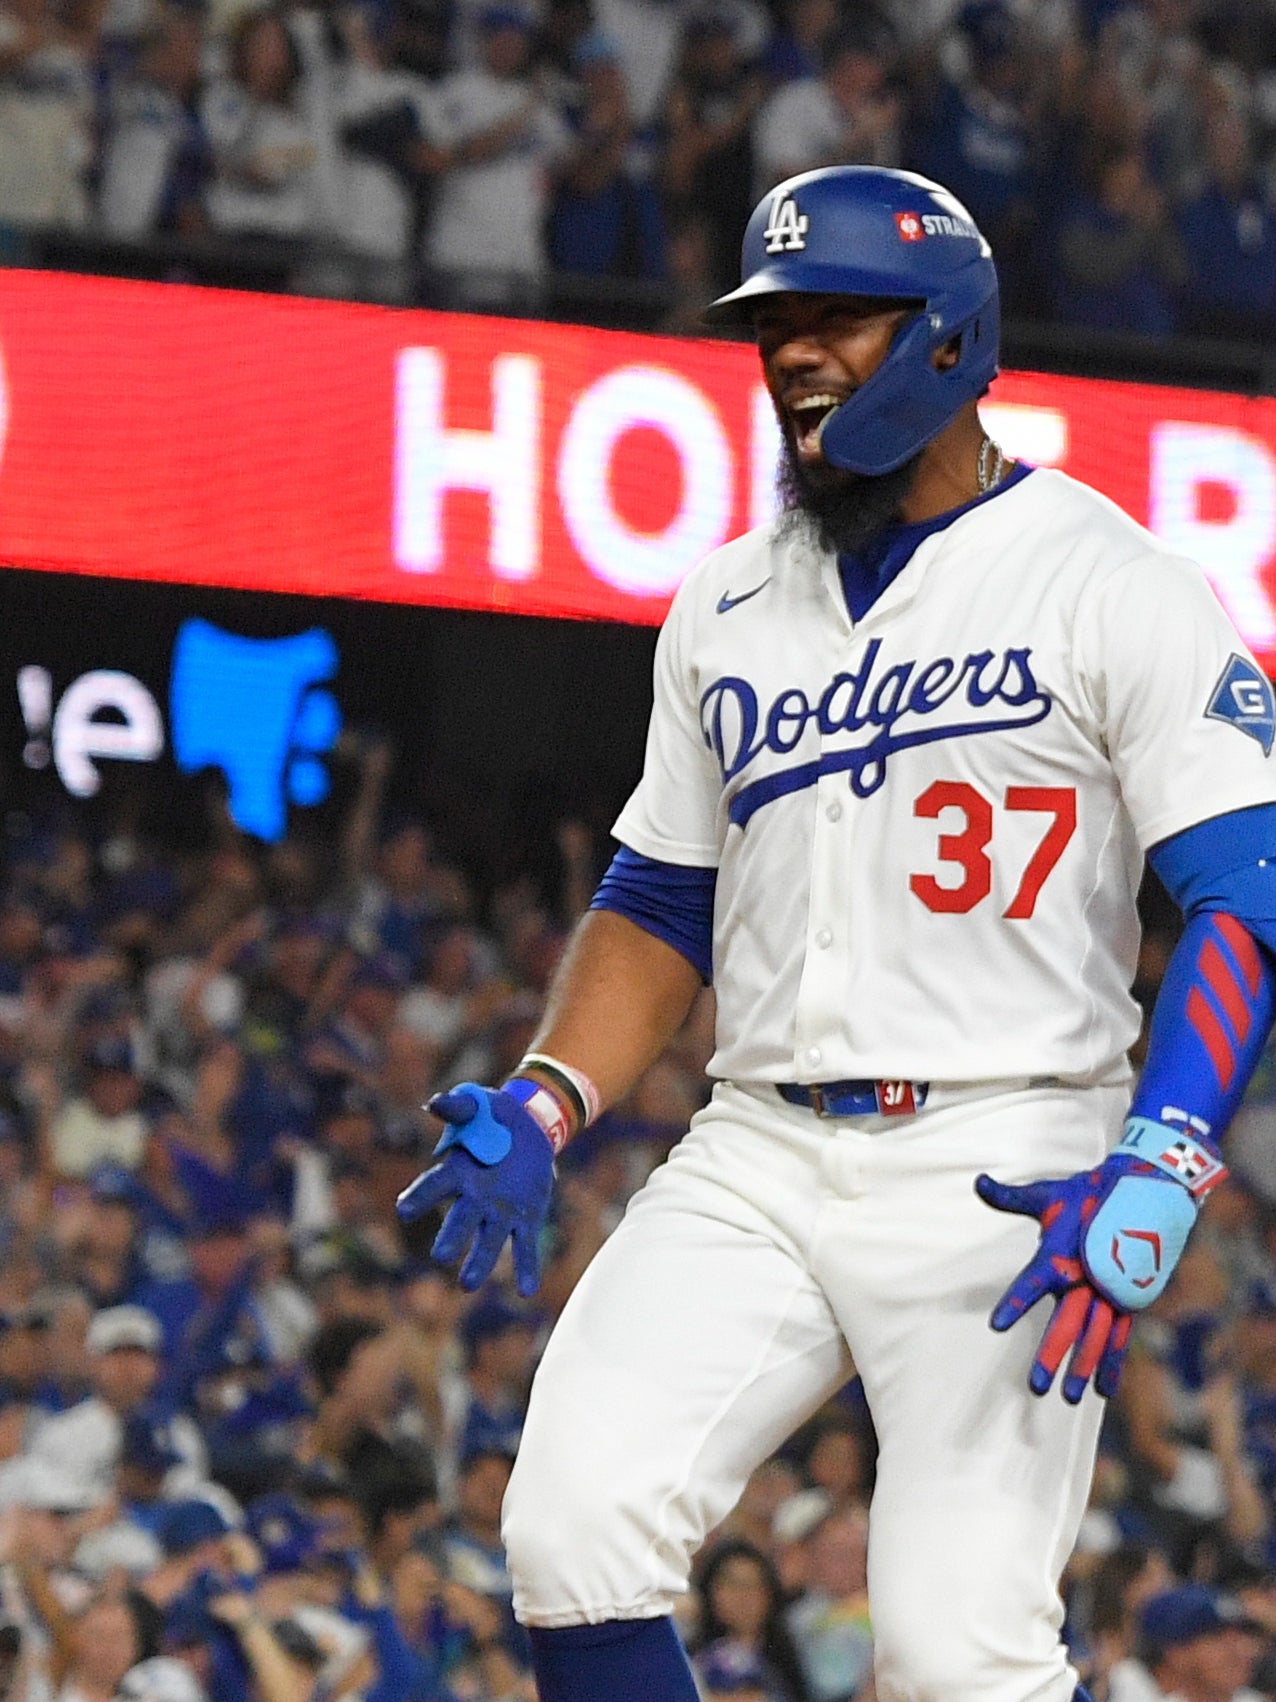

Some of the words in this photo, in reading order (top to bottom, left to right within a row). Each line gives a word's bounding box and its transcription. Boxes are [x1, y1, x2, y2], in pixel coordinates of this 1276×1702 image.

[763, 189, 809, 253] LA
[700, 638, 1052, 826] Dodgers
[909, 779, 1077, 919] 37
